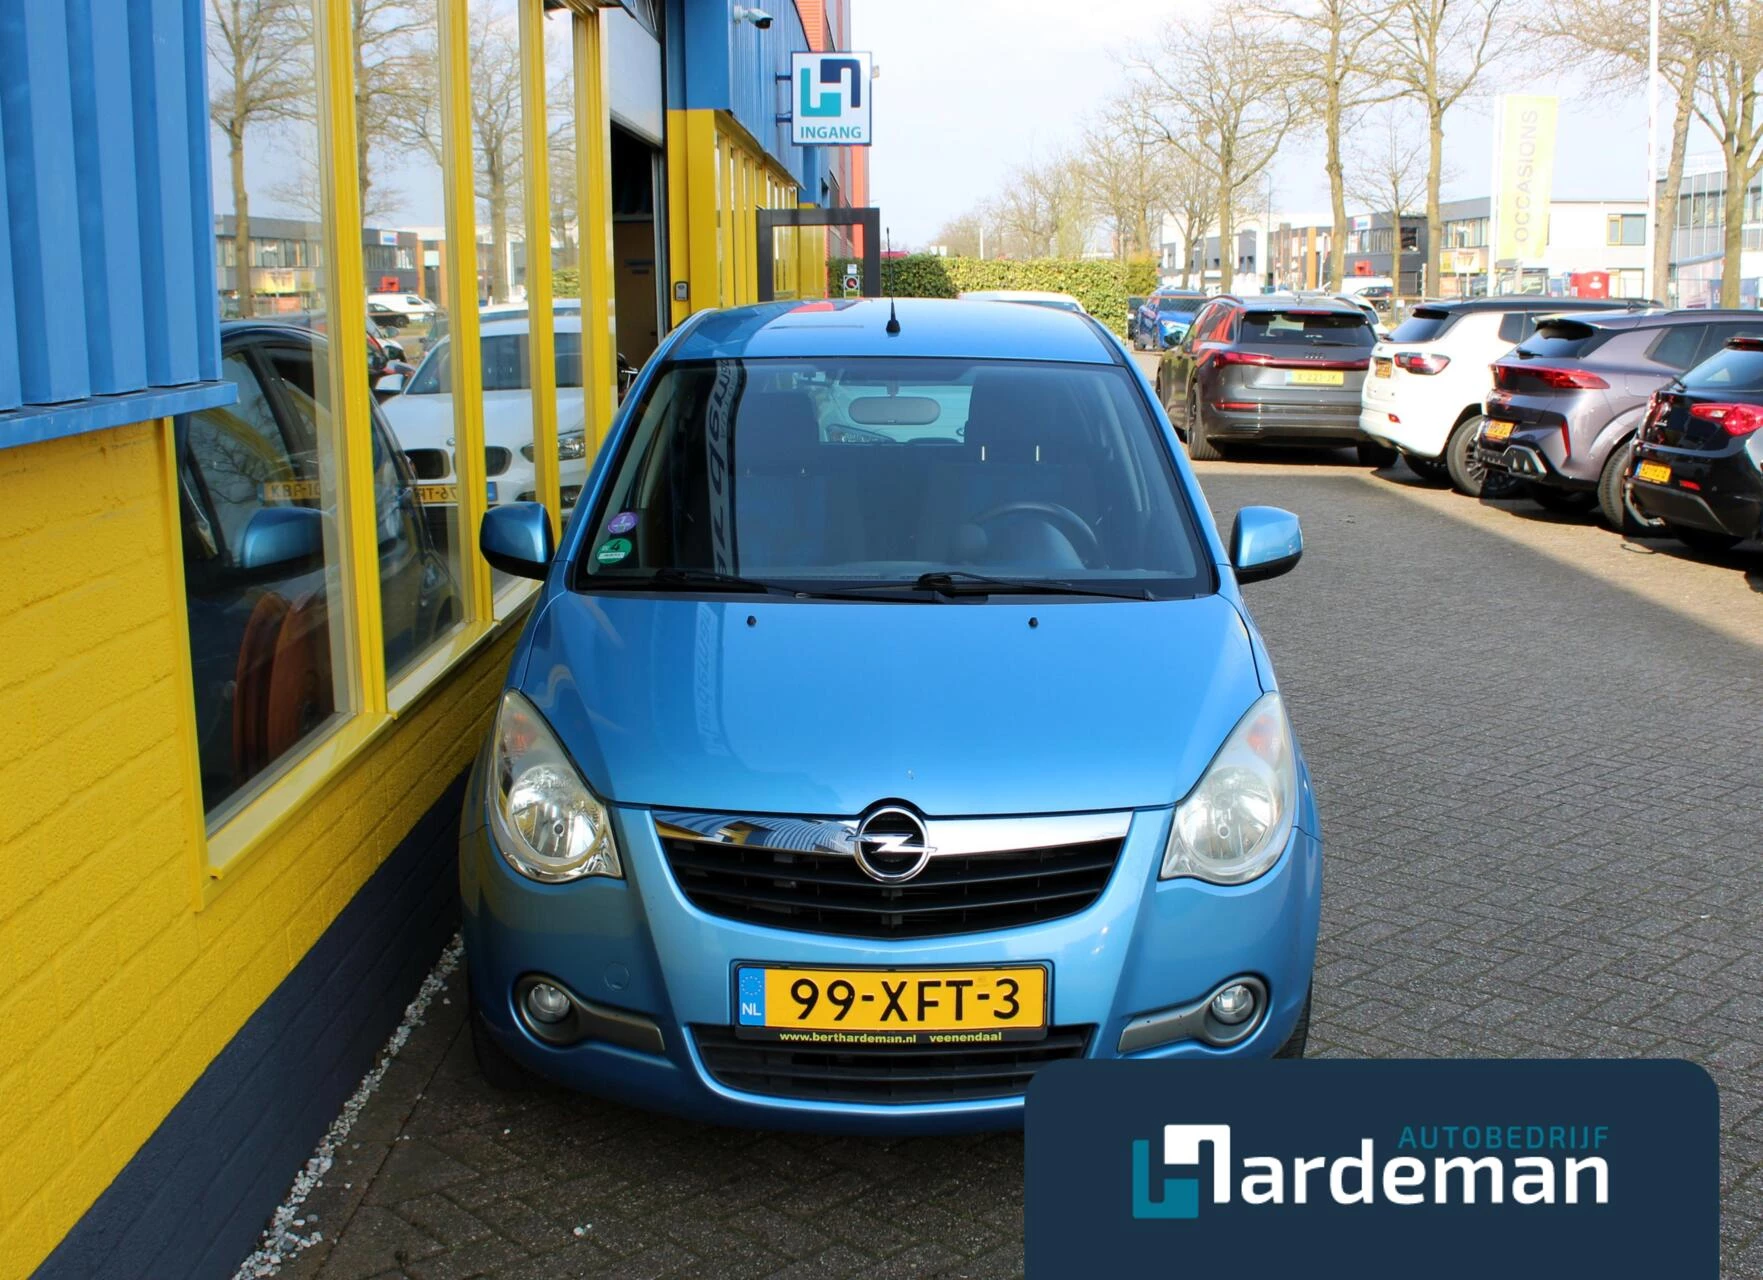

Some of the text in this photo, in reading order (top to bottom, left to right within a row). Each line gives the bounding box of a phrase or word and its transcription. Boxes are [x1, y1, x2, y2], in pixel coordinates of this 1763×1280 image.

[800, 126, 862, 139] INGANG
[1513, 109, 1538, 242] OCCASIONS
[790, 978, 1020, 1022] 99-XFT-3
[742, 1003, 762, 1016] NL
[779, 1032, 1002, 1044] www.berthardeman.nl veenendaal
